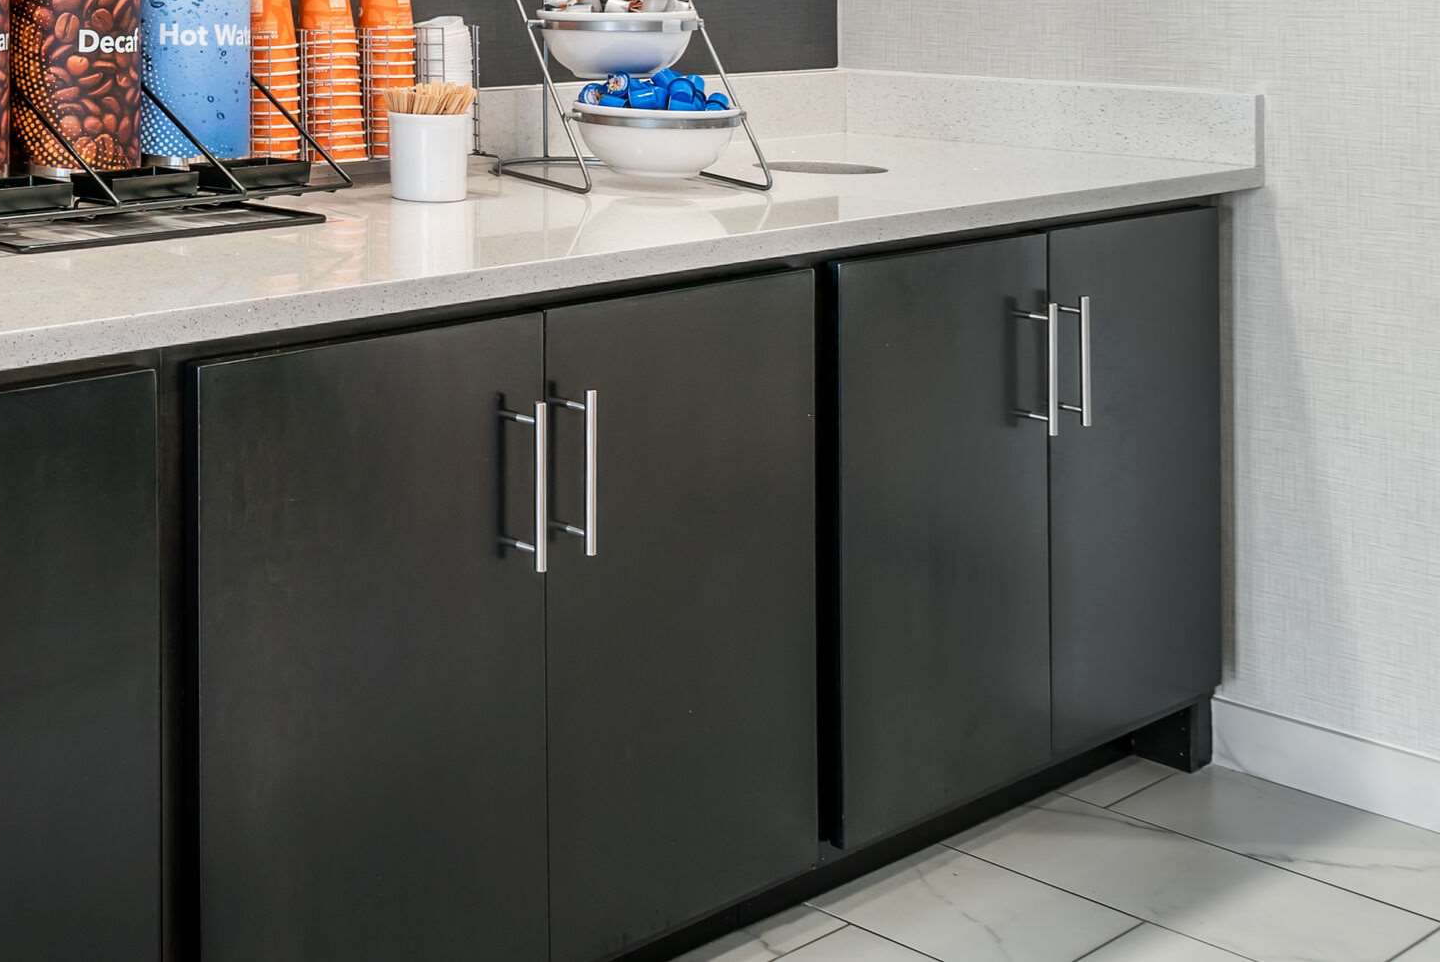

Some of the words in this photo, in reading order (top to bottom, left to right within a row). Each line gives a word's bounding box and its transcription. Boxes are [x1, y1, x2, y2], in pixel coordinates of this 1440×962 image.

[78, 27, 138, 53] Decaf
[160, 22, 208, 46] Hot
[214, 23, 251, 46] Wat
